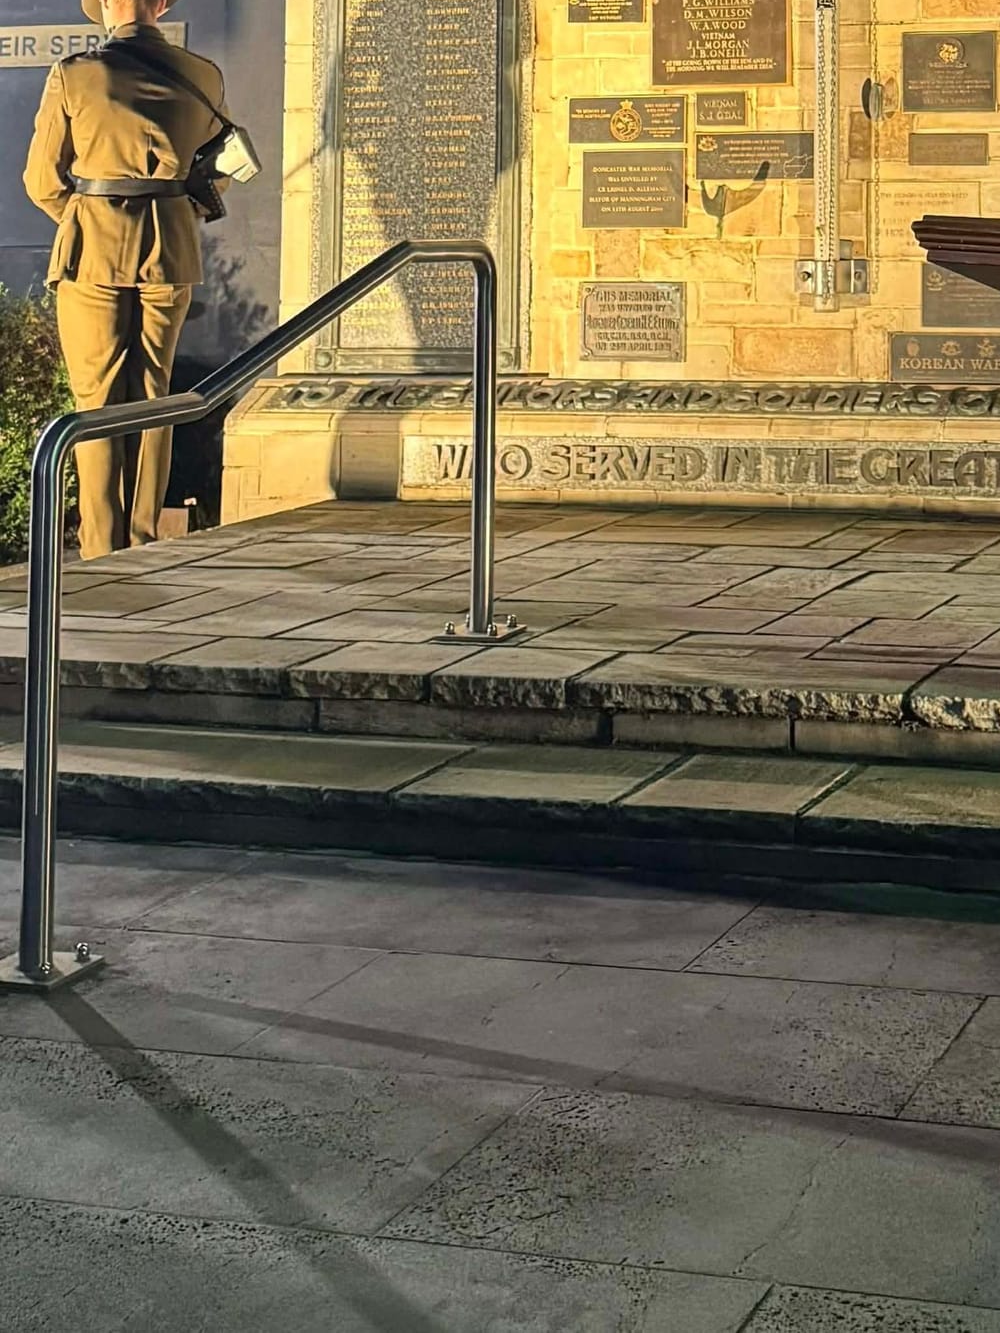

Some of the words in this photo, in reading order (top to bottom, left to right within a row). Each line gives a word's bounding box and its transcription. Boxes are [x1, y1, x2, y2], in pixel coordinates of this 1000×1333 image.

[701, 32, 735, 40] VIETNAM
[900, 357, 964, 370] KOREAN
[722, 383, 944, 415] SOLDIERS
[542, 444, 705, 482] SERVED
[714, 445, 762, 483] IN
[765, 446, 858, 485] THE
